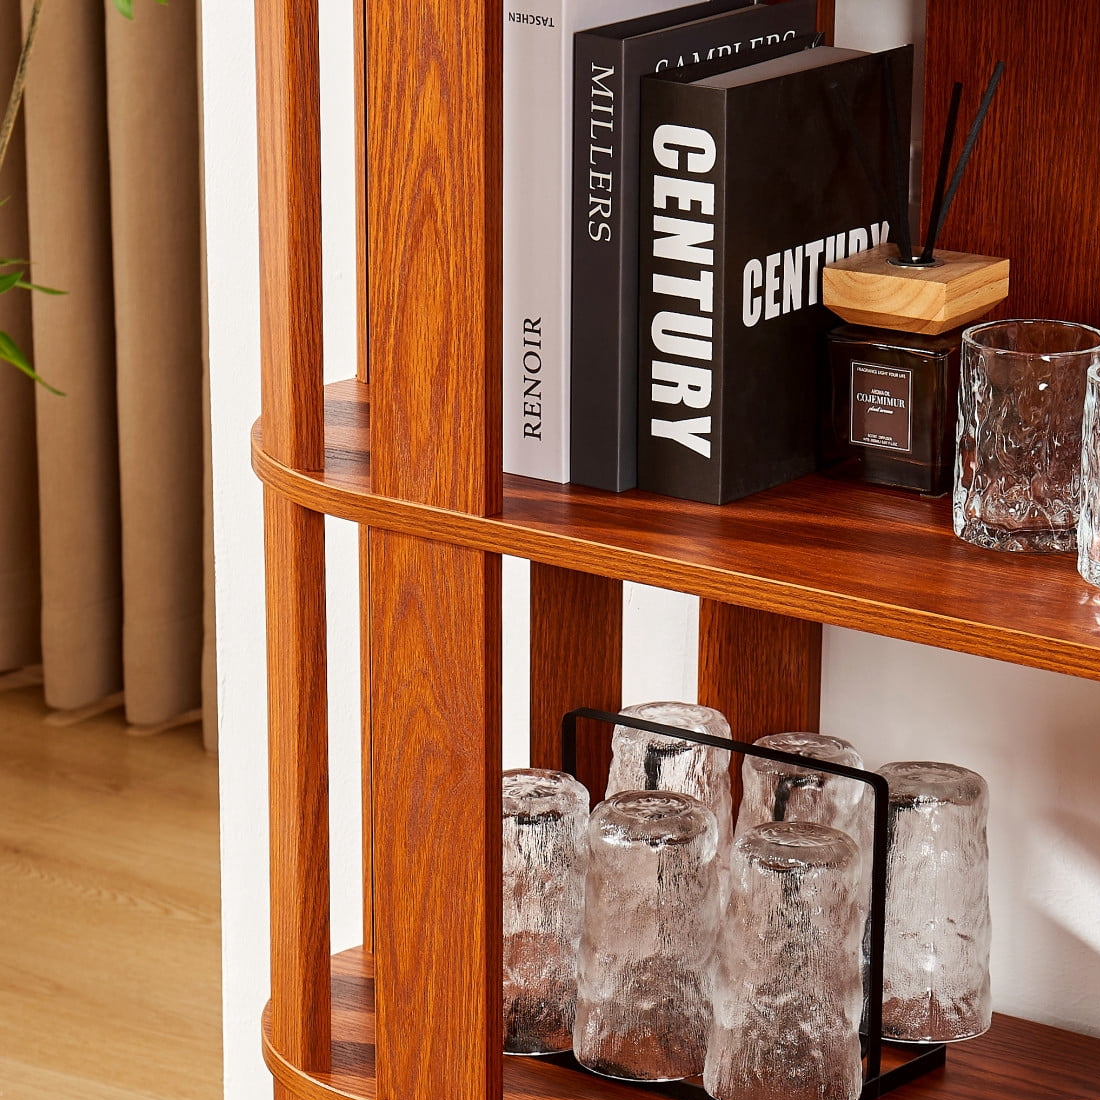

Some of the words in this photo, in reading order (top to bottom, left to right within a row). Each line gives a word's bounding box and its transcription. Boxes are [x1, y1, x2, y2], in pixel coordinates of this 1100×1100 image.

[508, 12, 555, 28] TASCHEN
[587, 62, 615, 243] MILLERS
[650, 123, 716, 459] CENTURY
[522, 316, 542, 442] RENOIR
[857, 392, 905, 408] COJEMIMUR
